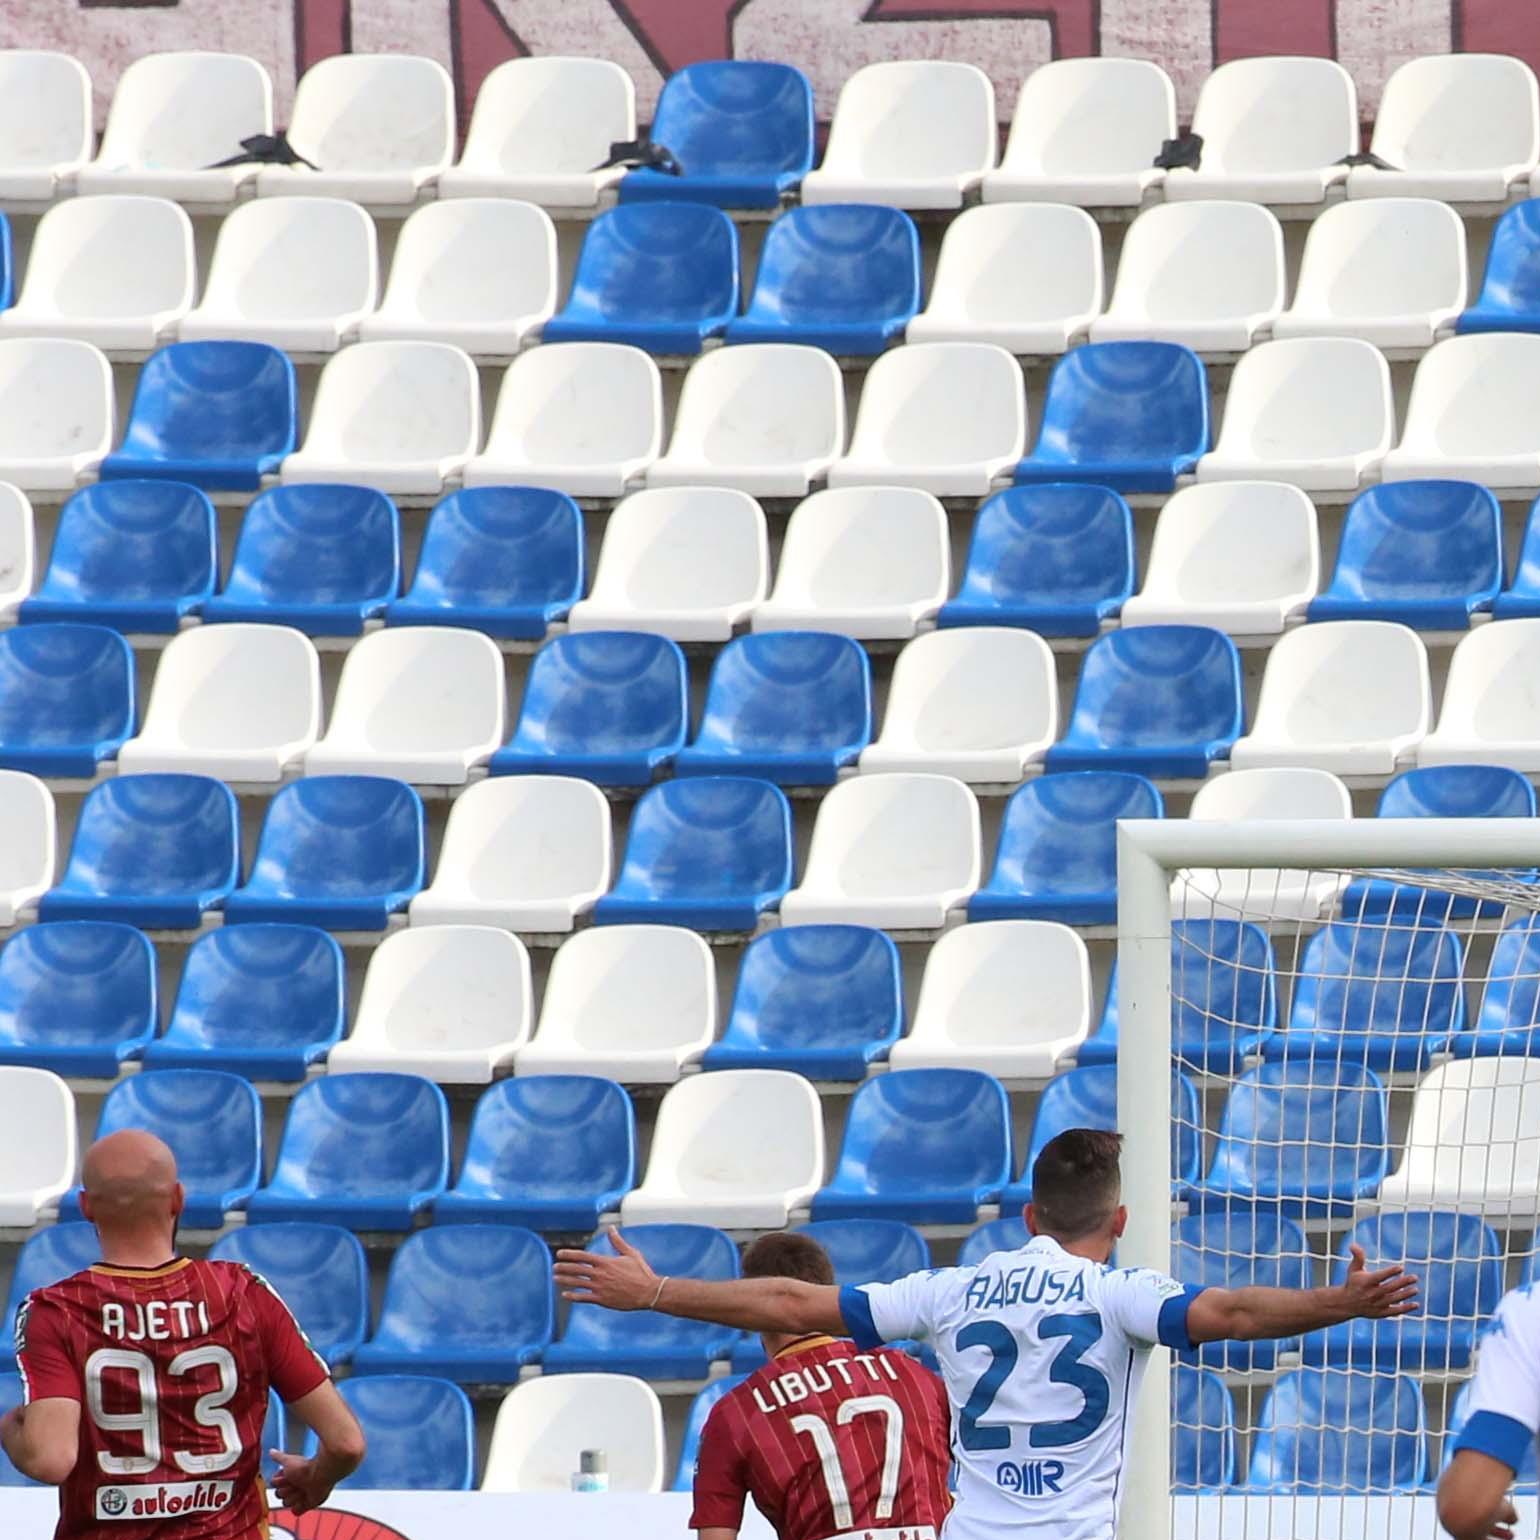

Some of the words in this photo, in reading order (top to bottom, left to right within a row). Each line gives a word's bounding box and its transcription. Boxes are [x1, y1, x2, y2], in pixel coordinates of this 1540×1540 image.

[101, 1300, 211, 1341] AJETI
[964, 1268, 1086, 1311] RAGUSA
[85, 1344, 244, 1477] 93
[751, 1351, 899, 1415] LIBUTTI
[955, 1311, 1111, 1451] 23
[790, 1394, 905, 1531] 17
[131, 1483, 231, 1518] autostile
